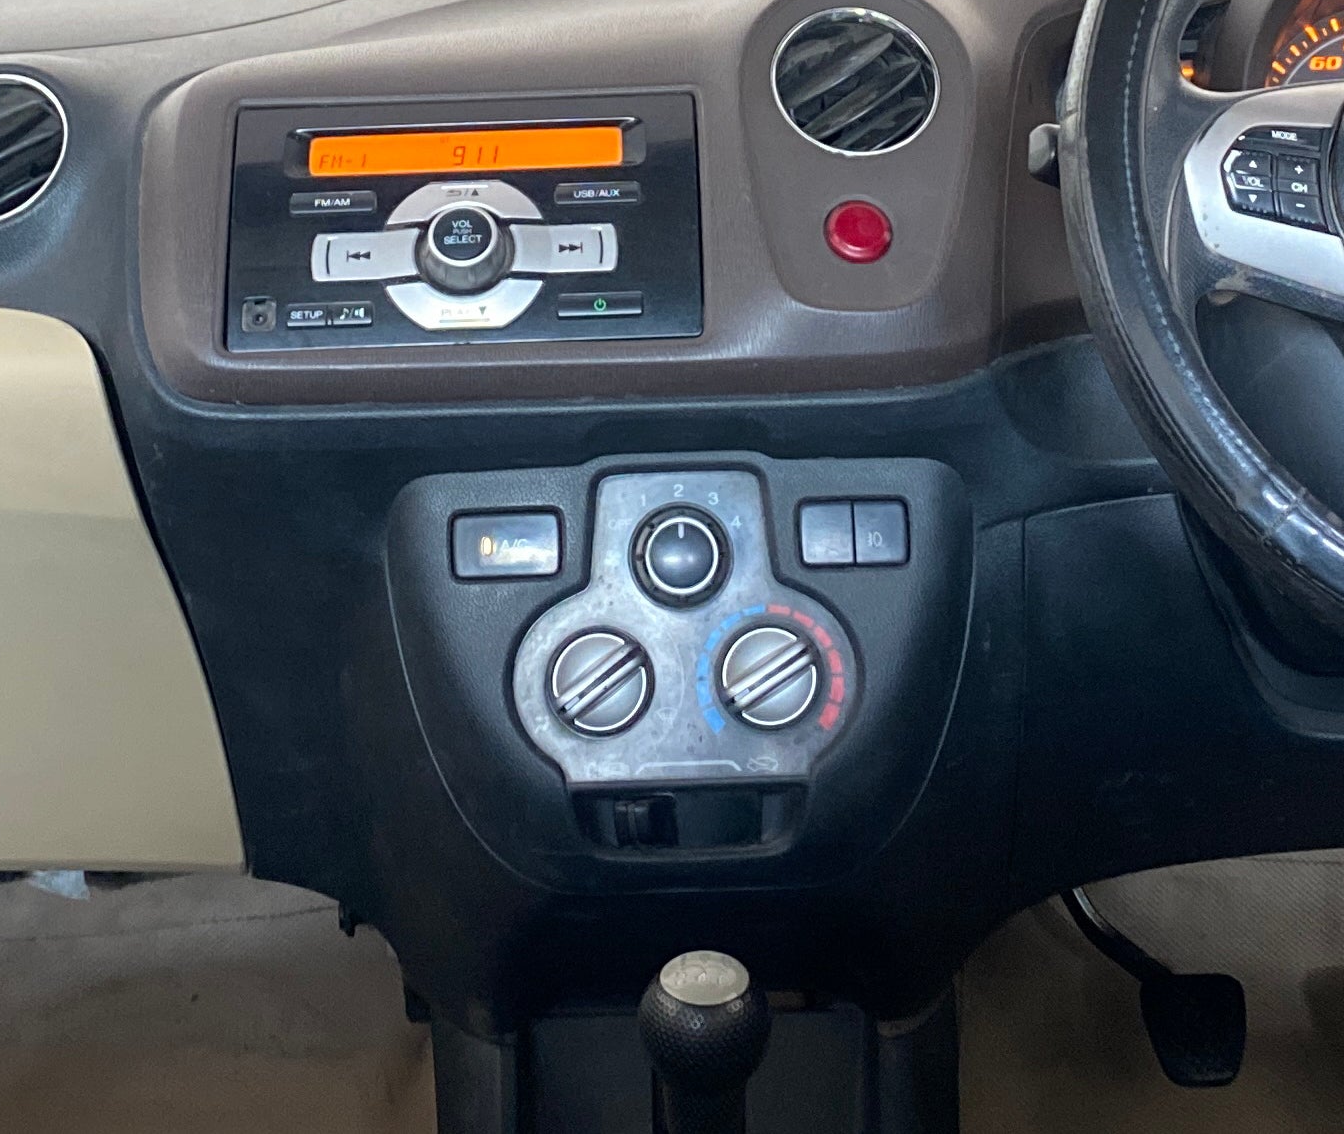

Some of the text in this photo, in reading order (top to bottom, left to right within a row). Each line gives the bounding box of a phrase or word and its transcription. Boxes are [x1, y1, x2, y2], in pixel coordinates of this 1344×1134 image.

[1309, 56, 1343, 71] 60
[1271, 130, 1298, 142] MODE
[573, 188, 620, 199] USB/AUX
[314, 198, 351, 208] FM/AM
[452, 219, 473, 229] VOL
[443, 234, 483, 245] SELECT
[290, 310, 324, 320] SETUP
[673, 483, 685, 498] 2
[640, 493, 647, 507] 1
[708, 491, 719, 506] 3
[730, 515, 743, 530] 4
